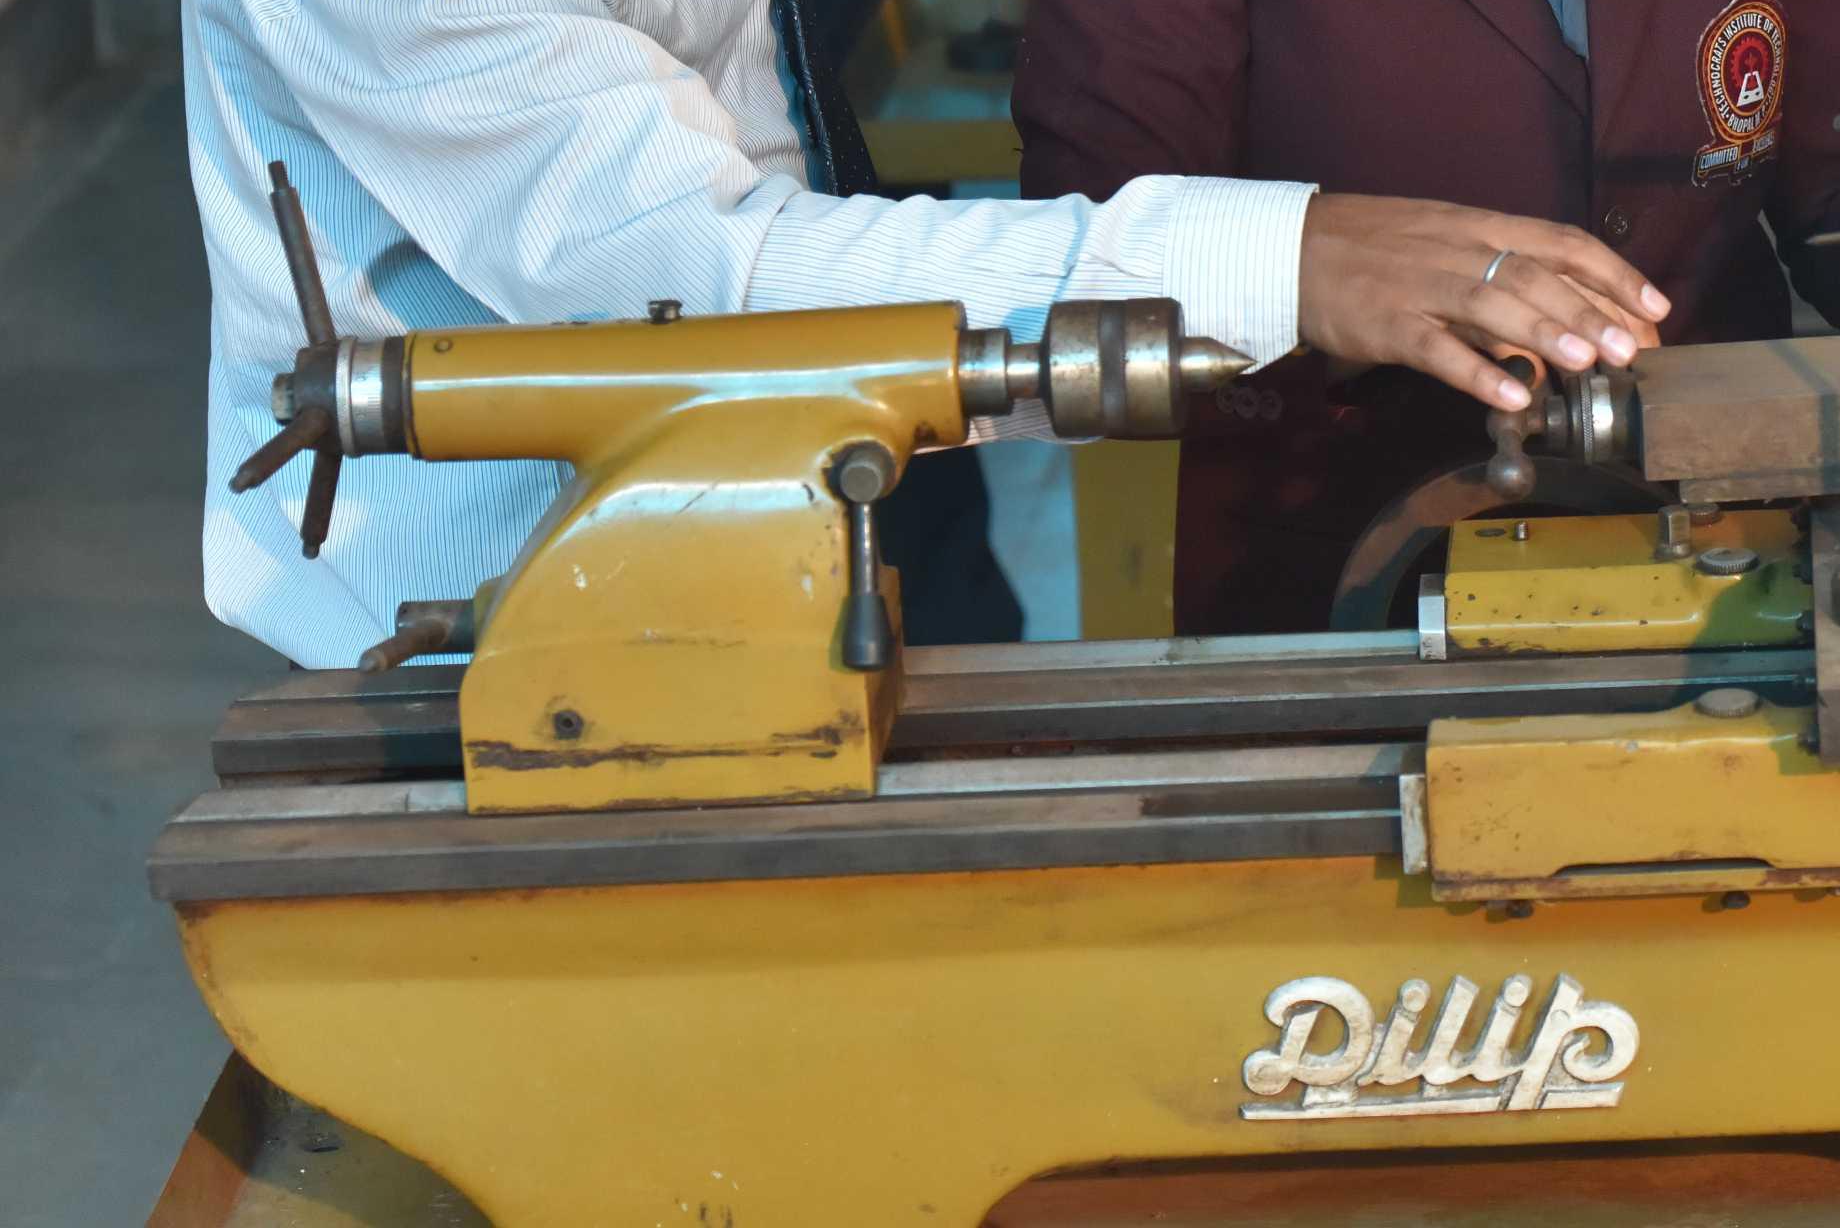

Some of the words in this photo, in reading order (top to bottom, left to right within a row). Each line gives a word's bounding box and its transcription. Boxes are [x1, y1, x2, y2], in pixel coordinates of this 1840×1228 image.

[1711, 36, 1729, 118] TECHNOCRATS
[1723, 13, 1762, 40] INSTITUTE
[1763, 18, 1774, 34] OF
[1728, 113, 1755, 133] BHOPAL
[1700, 146, 1738, 169] COMMITTED
[1242, 973, 1640, 1110] Dilip
